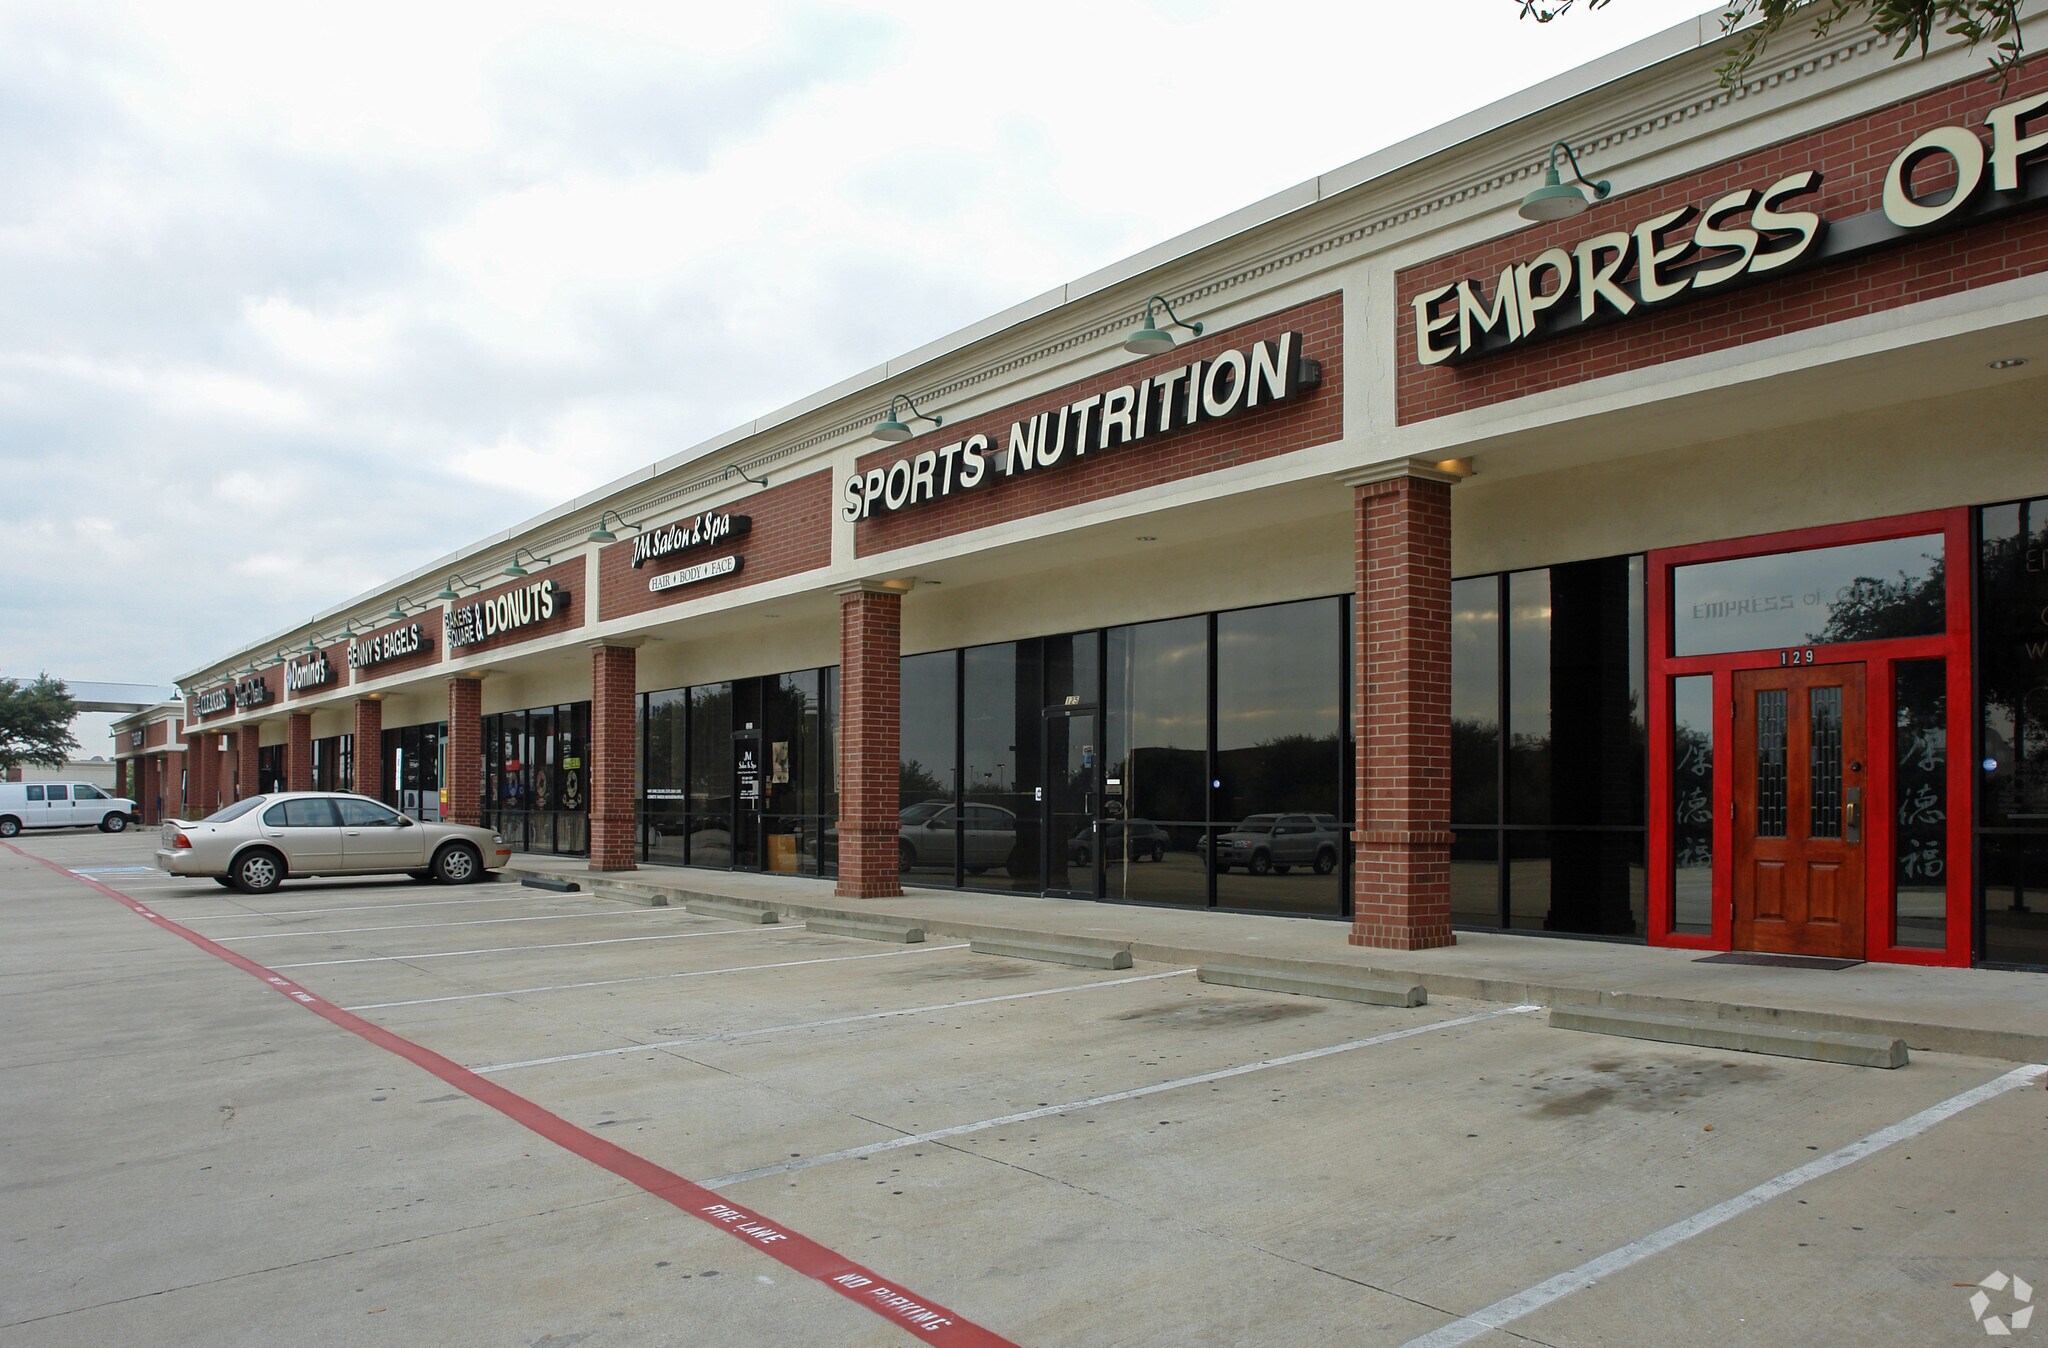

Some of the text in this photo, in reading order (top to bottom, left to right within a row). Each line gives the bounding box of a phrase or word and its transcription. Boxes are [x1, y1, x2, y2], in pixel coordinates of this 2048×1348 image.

[1411, 91, 2048, 366] EMPRESS OF
[842, 331, 1294, 523] SPORTS NUTRITION
[631, 511, 730, 568] JM Salon & Spa
[651, 557, 733, 590] HAIR BODY FACE
[443, 605, 473, 630] BAKERS
[475, 579, 554, 642] & DONUTS
[1692, 595, 1794, 619] EMPRESS
[347, 623, 418, 669] BENNY'S BAGELS
[447, 624, 475, 649] SQUARE
[292, 657, 326, 690] Domino's
[1782, 650, 1813, 665] 129
[1066, 696, 1079, 705] 125
[701, 1204, 788, 1244] FIRE LANE
[832, 1273, 953, 1331] NO PARKING
